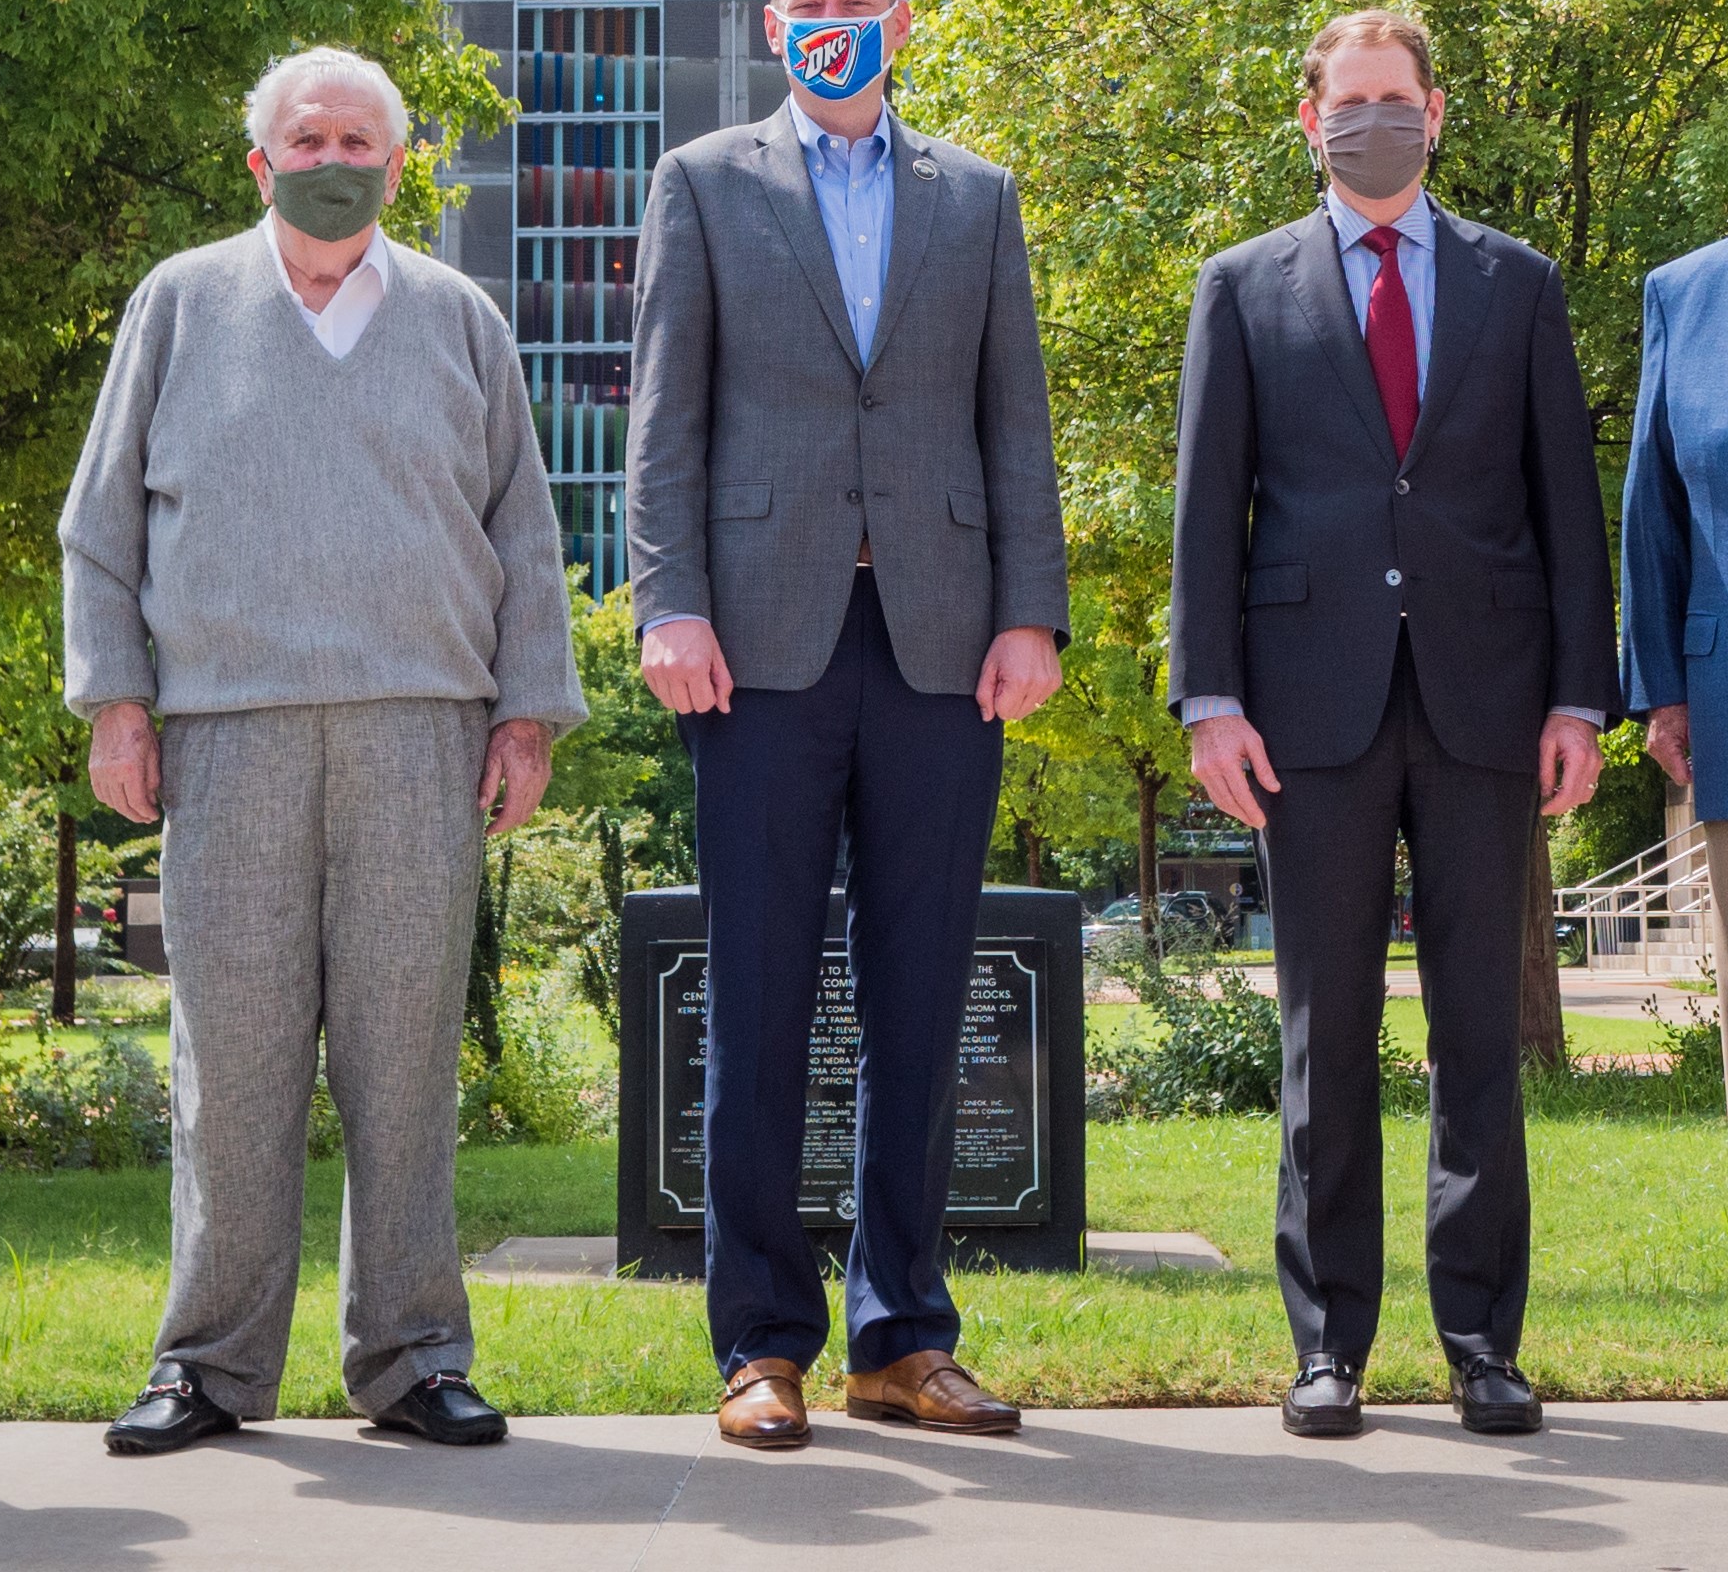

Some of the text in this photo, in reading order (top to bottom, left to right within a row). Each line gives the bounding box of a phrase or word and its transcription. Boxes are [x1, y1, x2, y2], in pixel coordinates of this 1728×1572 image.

[805, 33, 848, 80] OKC
[827, 966, 841, 975] TO
[977, 965, 994, 974] THE
[969, 977, 997, 987] WING
[682, 991, 707, 1001] CENT
[825, 991, 841, 1000] THE
[970, 989, 1014, 999] CLOCKS.
[825, 1006, 855, 1014] COMM
[965, 1005, 997, 1013] AHOMA
[999, 1004, 1018, 1013] CITY
[830, 1016, 858, 1024] FAMILY
[964, 1015, 994, 1023] RATION
[809, 1046, 997, 1055] ORATION UTHORITY
[823, 1056, 851, 1065] NEDRA
[830, 1066, 859, 1076] COUNT
[818, 1077, 854, 1086] OFFICIAL
[981, 1108, 1015, 1116] COMPANY
